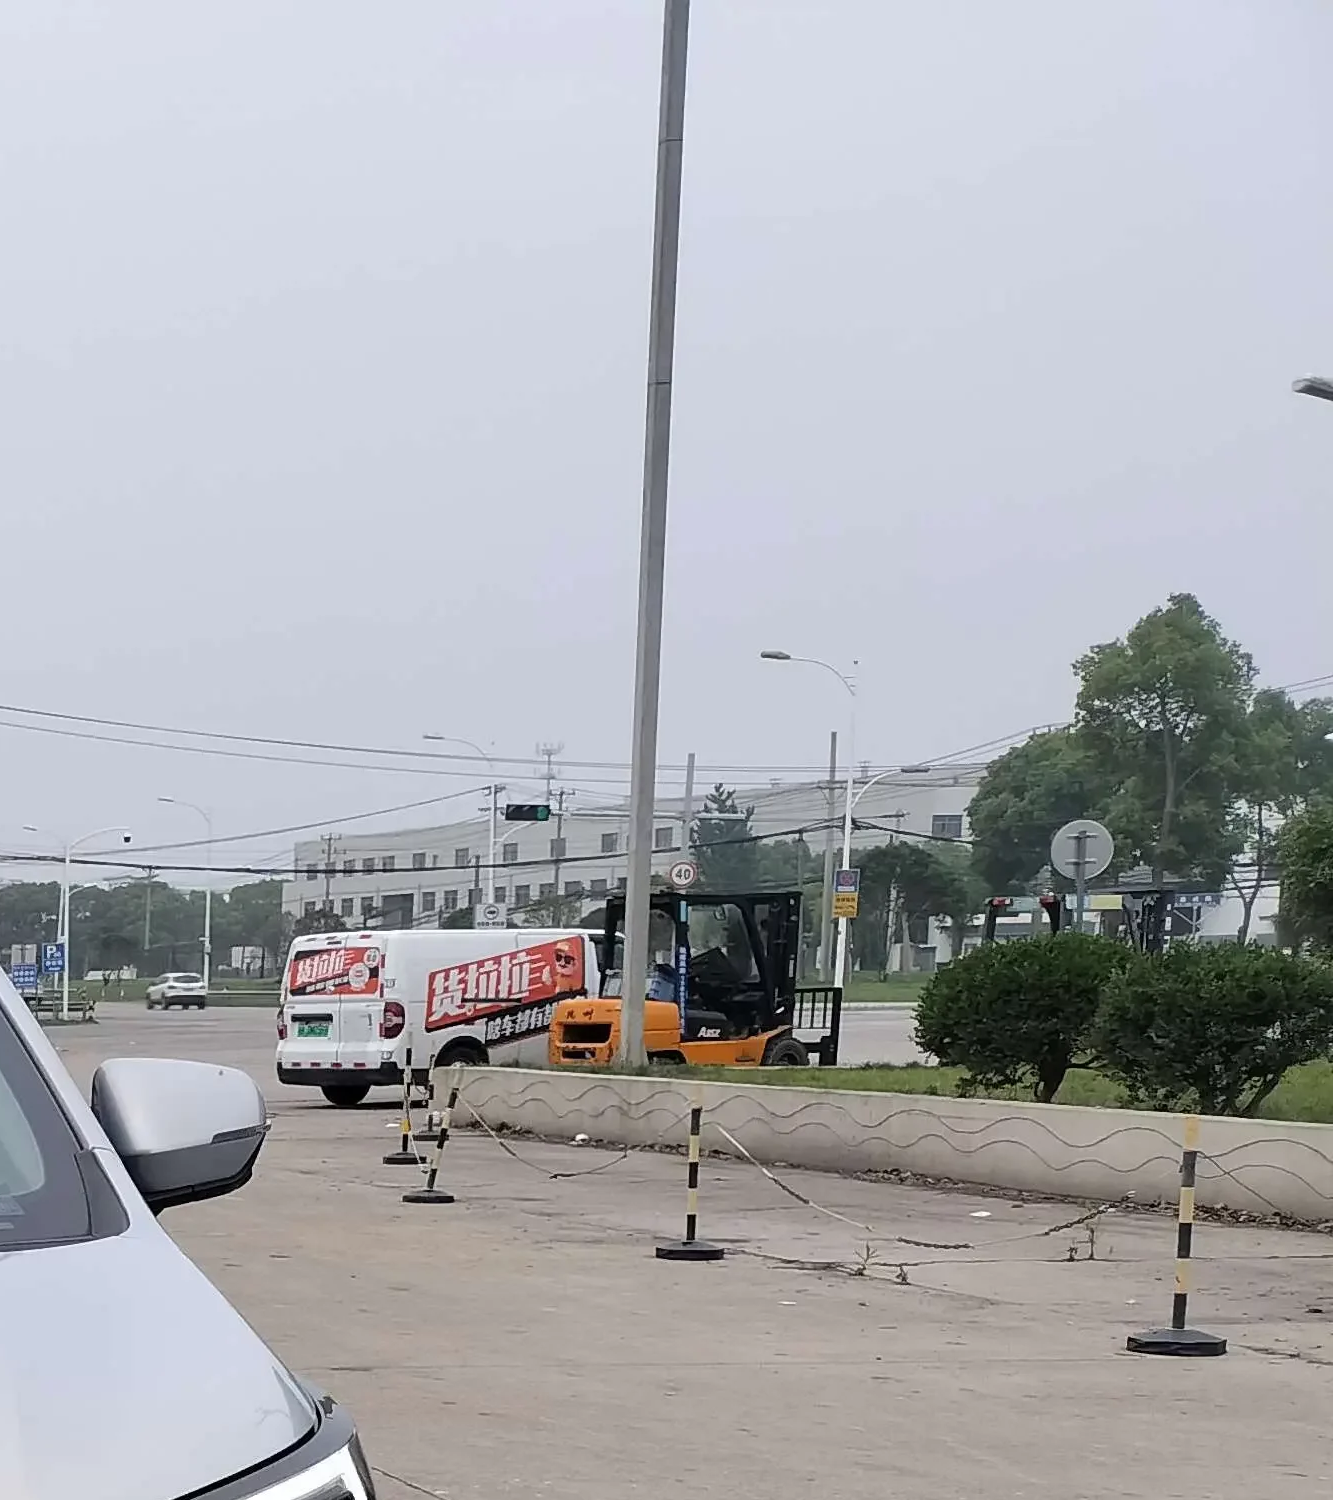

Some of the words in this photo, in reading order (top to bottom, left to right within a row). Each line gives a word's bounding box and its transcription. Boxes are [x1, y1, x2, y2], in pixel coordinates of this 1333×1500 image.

[675, 868, 691, 880] 40
[295, 949, 346, 985] 货拉拉
[428, 951, 531, 1022] 货拉拉
